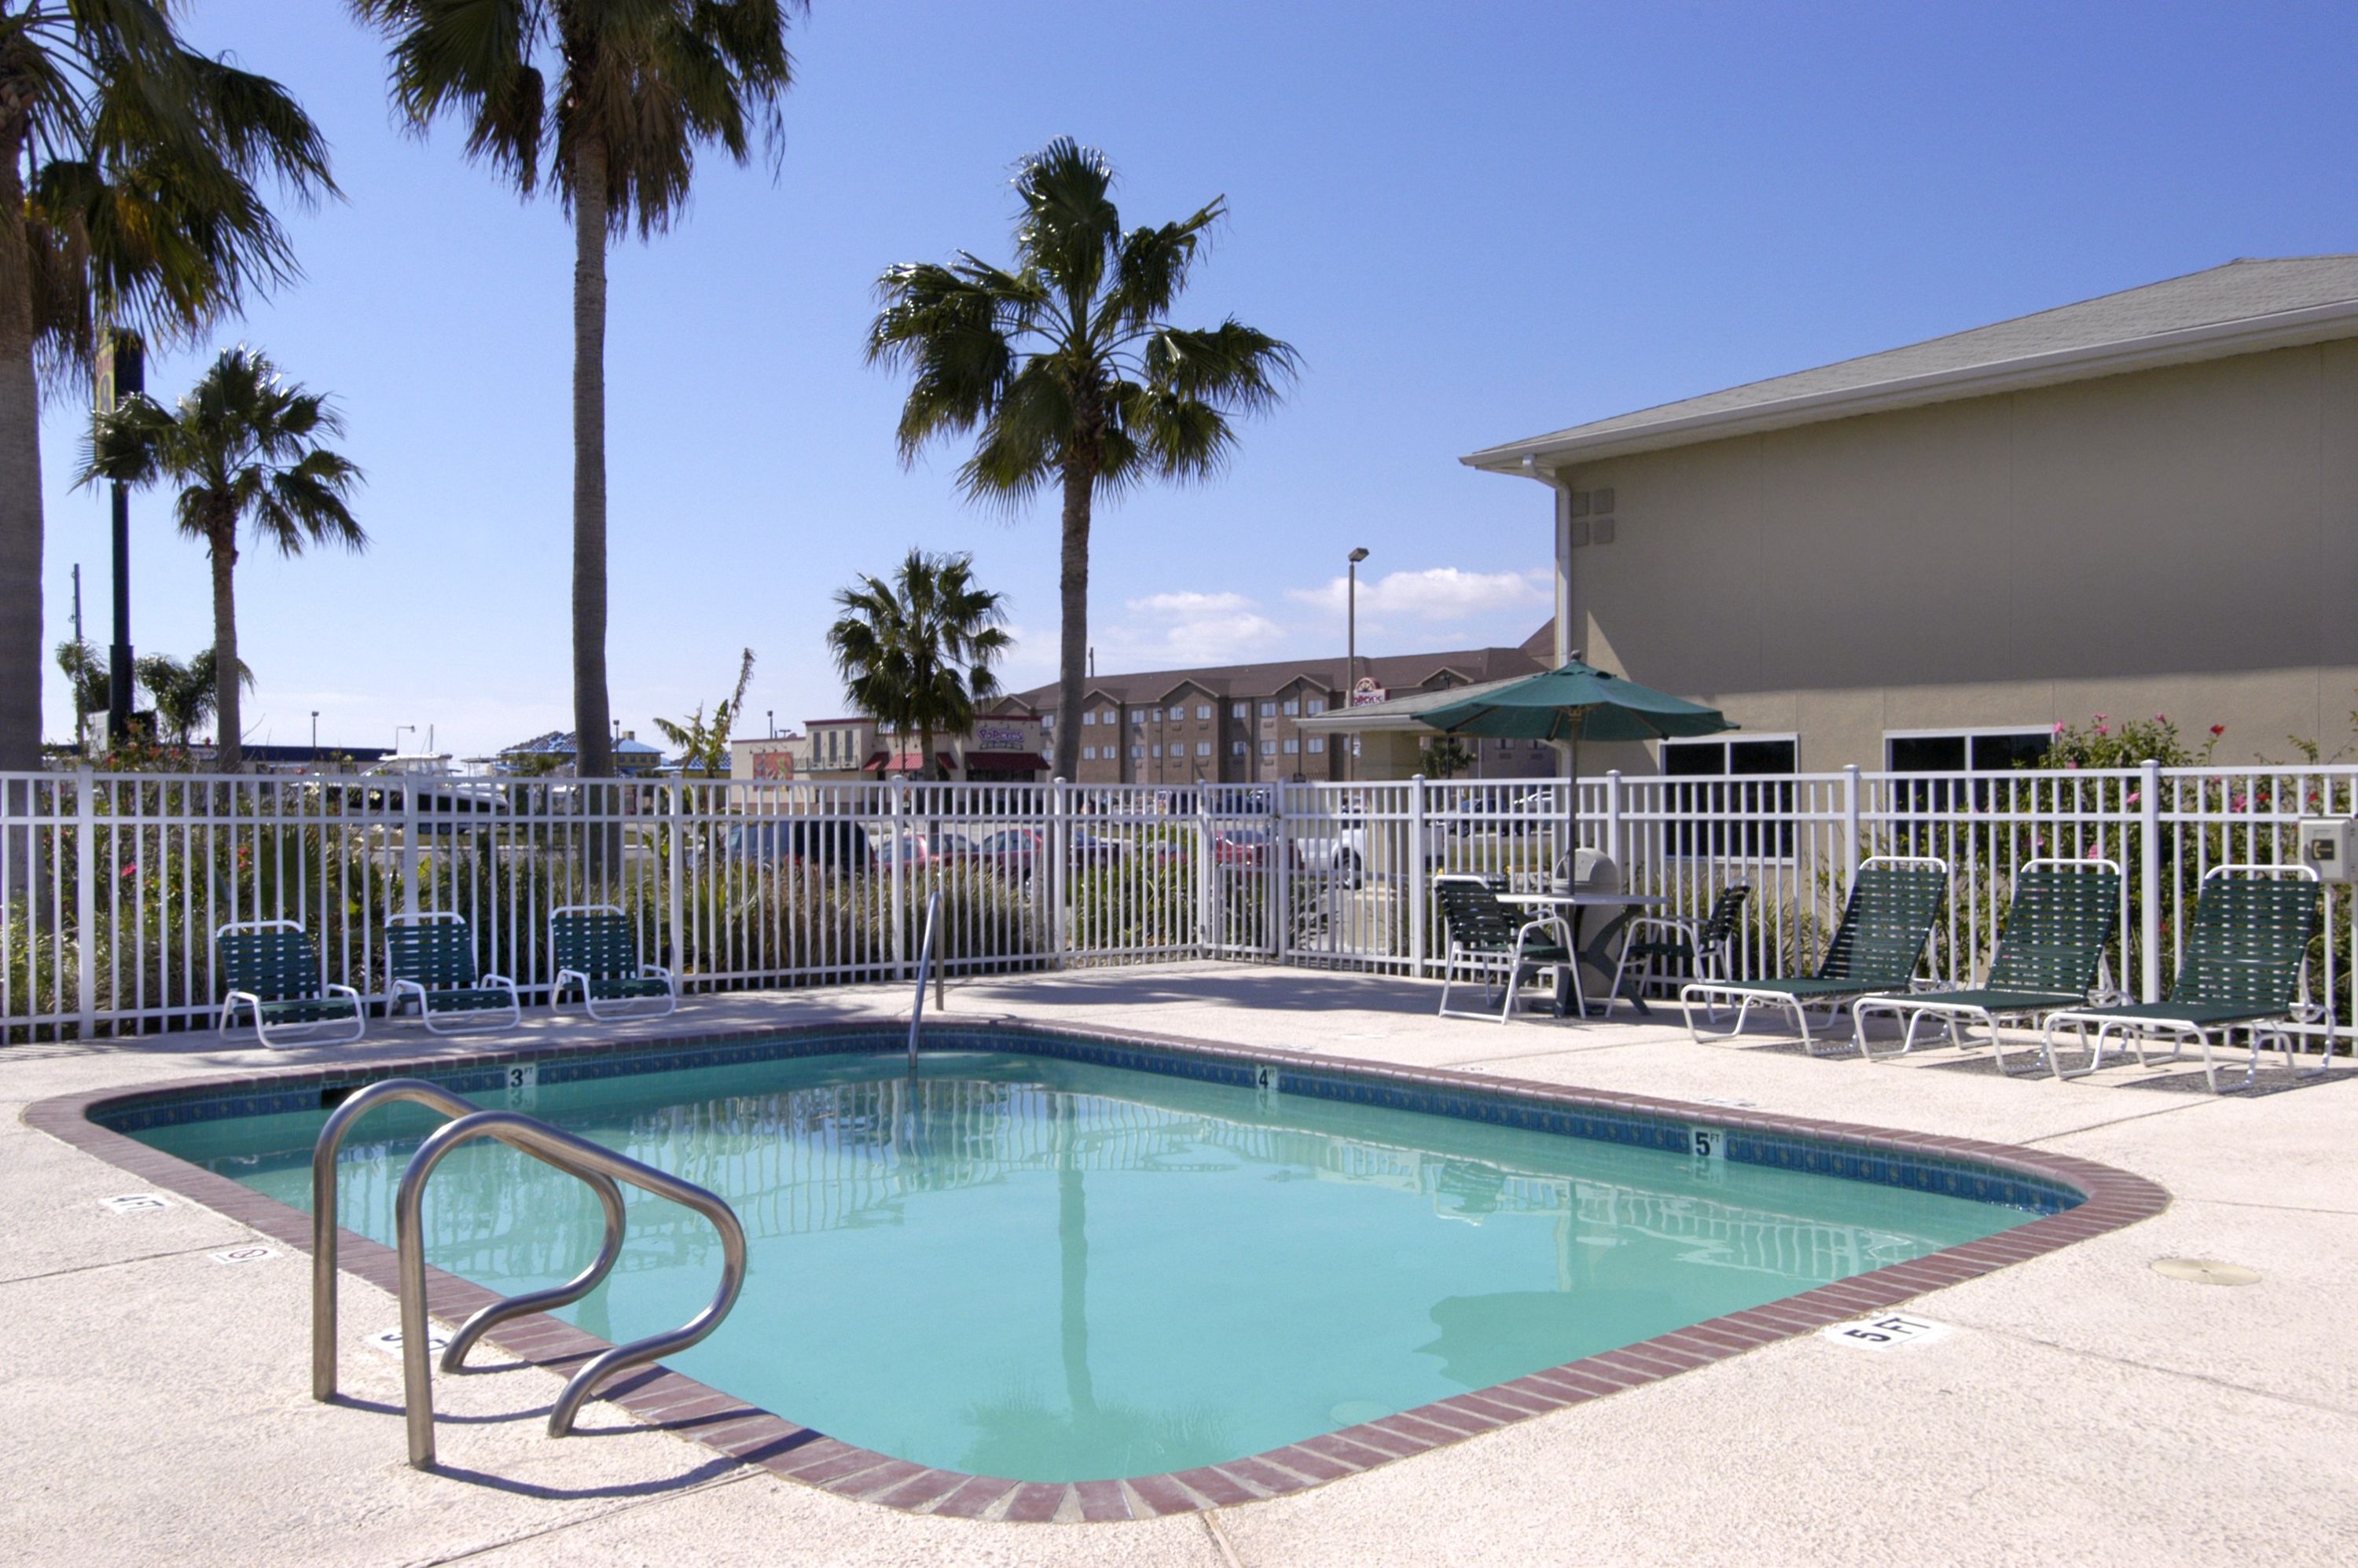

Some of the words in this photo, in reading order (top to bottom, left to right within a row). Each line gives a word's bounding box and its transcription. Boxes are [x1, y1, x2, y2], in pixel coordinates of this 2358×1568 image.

[511, 1068, 523, 1088] 3
[524, 1067, 534, 1075] FT
[1259, 1068, 1269, 1089] 4
[1695, 1131, 1710, 1157] 5
[1710, 1133, 1720, 1144] FT
[1843, 1329, 1891, 1342] 5
[1872, 1317, 1930, 1335] FT
